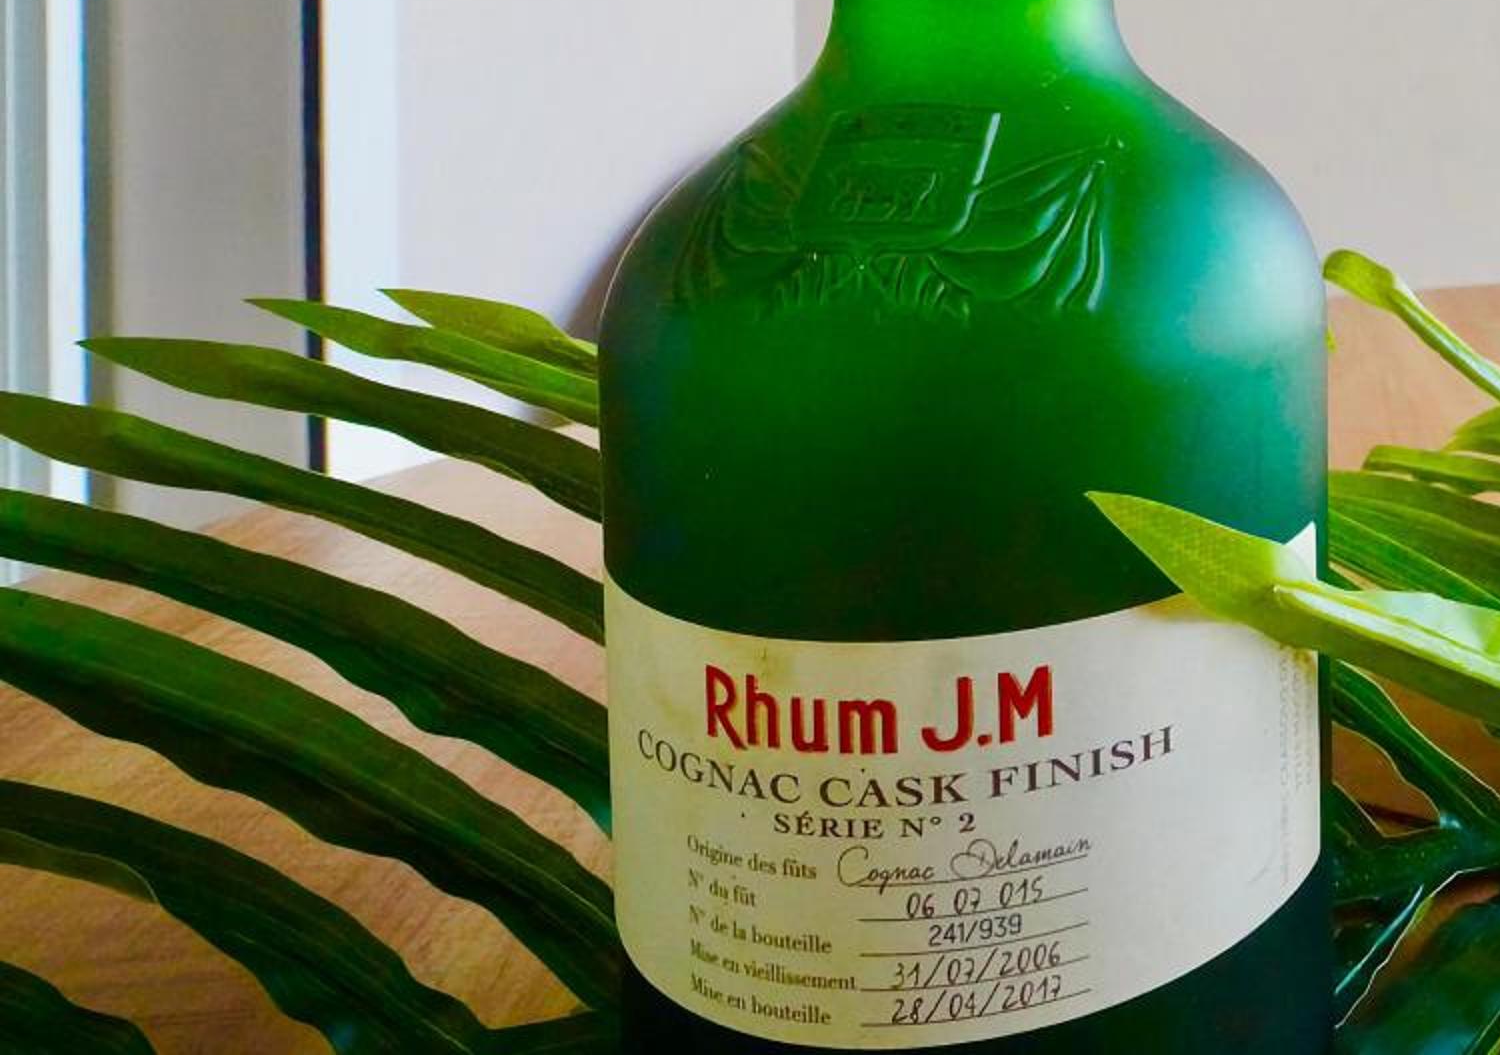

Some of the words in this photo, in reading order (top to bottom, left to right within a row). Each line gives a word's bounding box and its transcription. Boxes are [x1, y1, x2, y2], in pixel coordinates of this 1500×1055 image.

[704, 664, 899, 756] Rhum
[920, 664, 1055, 753] J.M
[637, 728, 801, 805] COGNAC
[819, 773, 969, 810] CASK
[990, 725, 1175, 800] FINISH
[773, 811, 885, 840] SÉRIE
[899, 813, 943, 839] N°
[957, 812, 976, 833] 2
[687, 834, 743, 866] Origine
[747, 853, 777, 875] des
[782, 857, 817, 879] fûts
[837, 845, 934, 895] Cognac
[950, 838, 1091, 882] Delamain
[709, 878, 729, 900] du
[733, 884, 756, 907] fût
[905, 892, 935, 920] 06
[710, 915, 728, 934] de
[732, 921, 747, 940] la
[752, 924, 832, 954] bouteille
[928, 912, 1022, 947] 241/939
[722, 957, 740, 974] en
[744, 960, 857, 990] vieillissement
[893, 941, 1062, 991] 31/07/2006
[727, 995, 746, 1010] en
[751, 995, 832, 1025] bouteille
[891, 975, 1062, 1026] 28/04/2017
